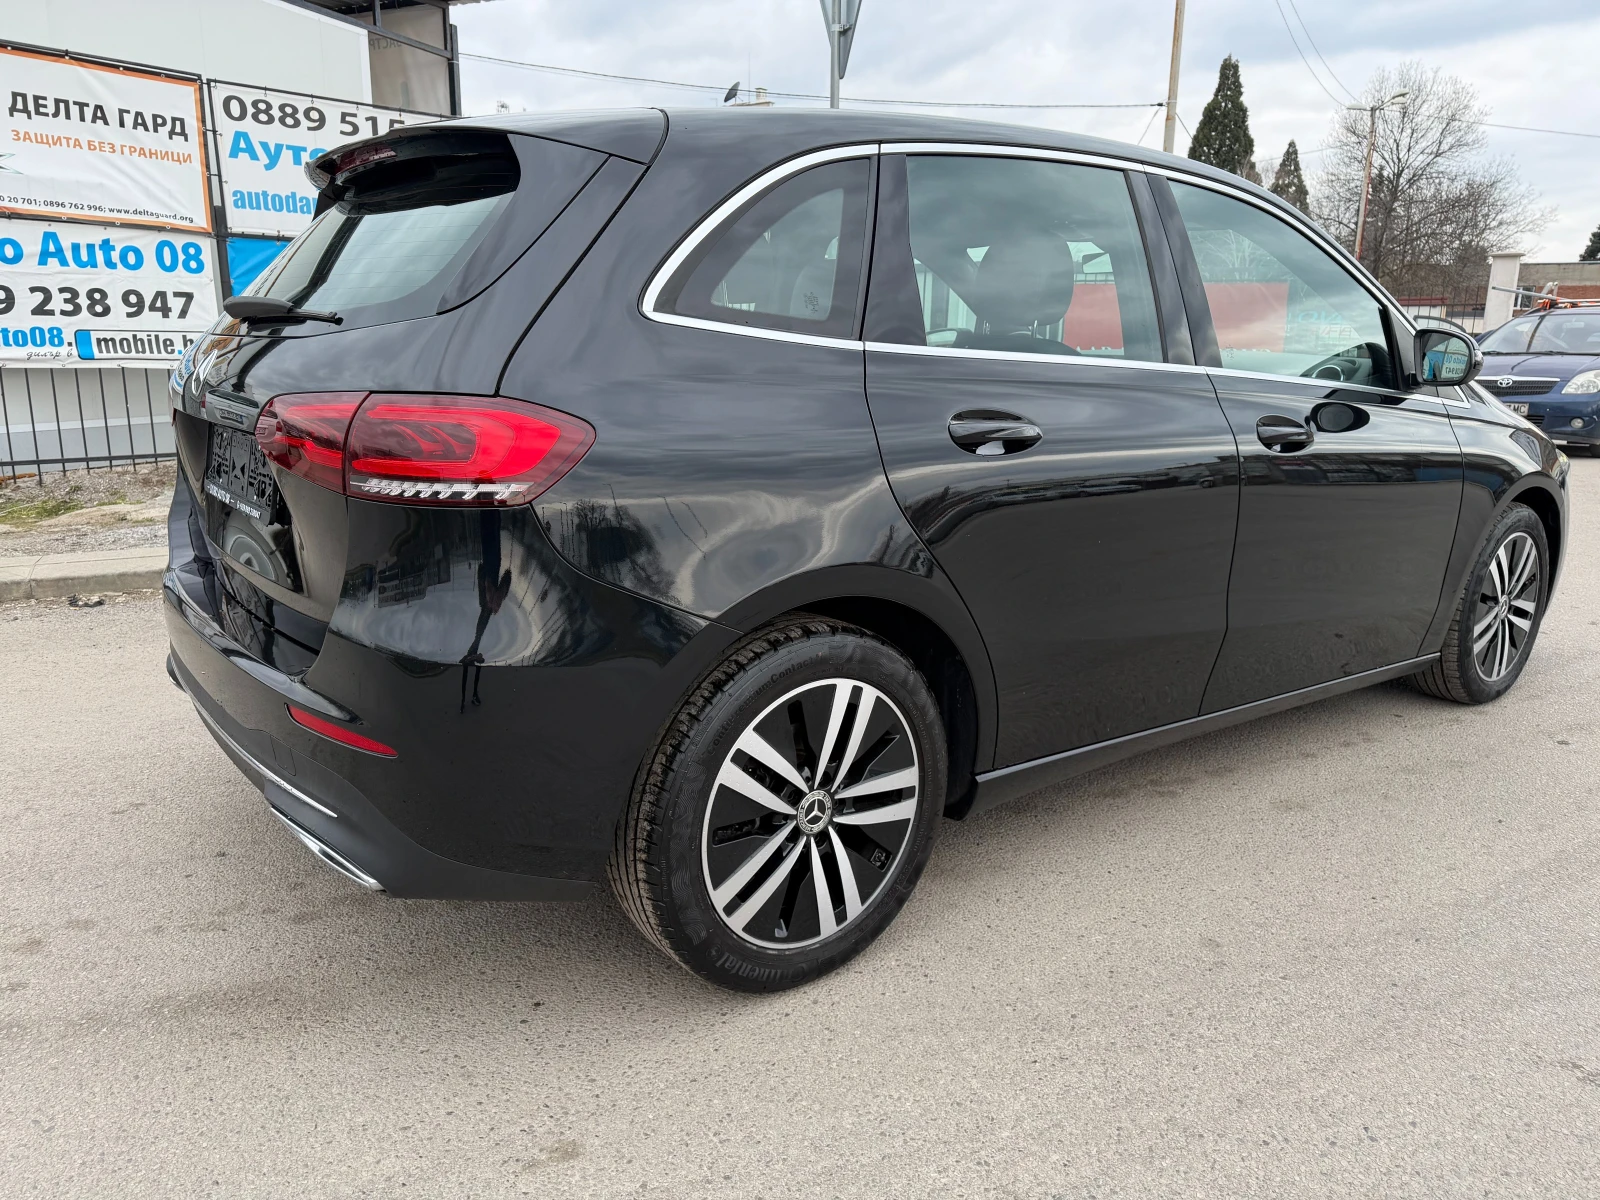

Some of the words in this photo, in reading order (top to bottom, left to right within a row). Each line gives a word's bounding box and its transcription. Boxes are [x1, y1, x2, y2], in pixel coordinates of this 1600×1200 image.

[8, 91, 110, 126] ДЕЛТА
[117, 108, 189, 142] ГАРД
[222, 95, 327, 132] 0889
[11, 129, 83, 149] ЗАЩИТА
[87, 139, 116, 154] БЕЗ
[120, 144, 192, 165] ГРАНИЦИ
[7, 195, 19, 204] 20
[20, 197, 41, 207] 701;
[43, 199, 66, 209] 0896
[68, 202, 85, 211] 762
[86, 204, 106, 214] 996;
[107, 206, 194, 223] www.deltaguard.org
[38, 231, 144, 271] Auto
[155, 239, 205, 274] 08
[28, 285, 111, 318] 238
[121, 288, 195, 319] 947
